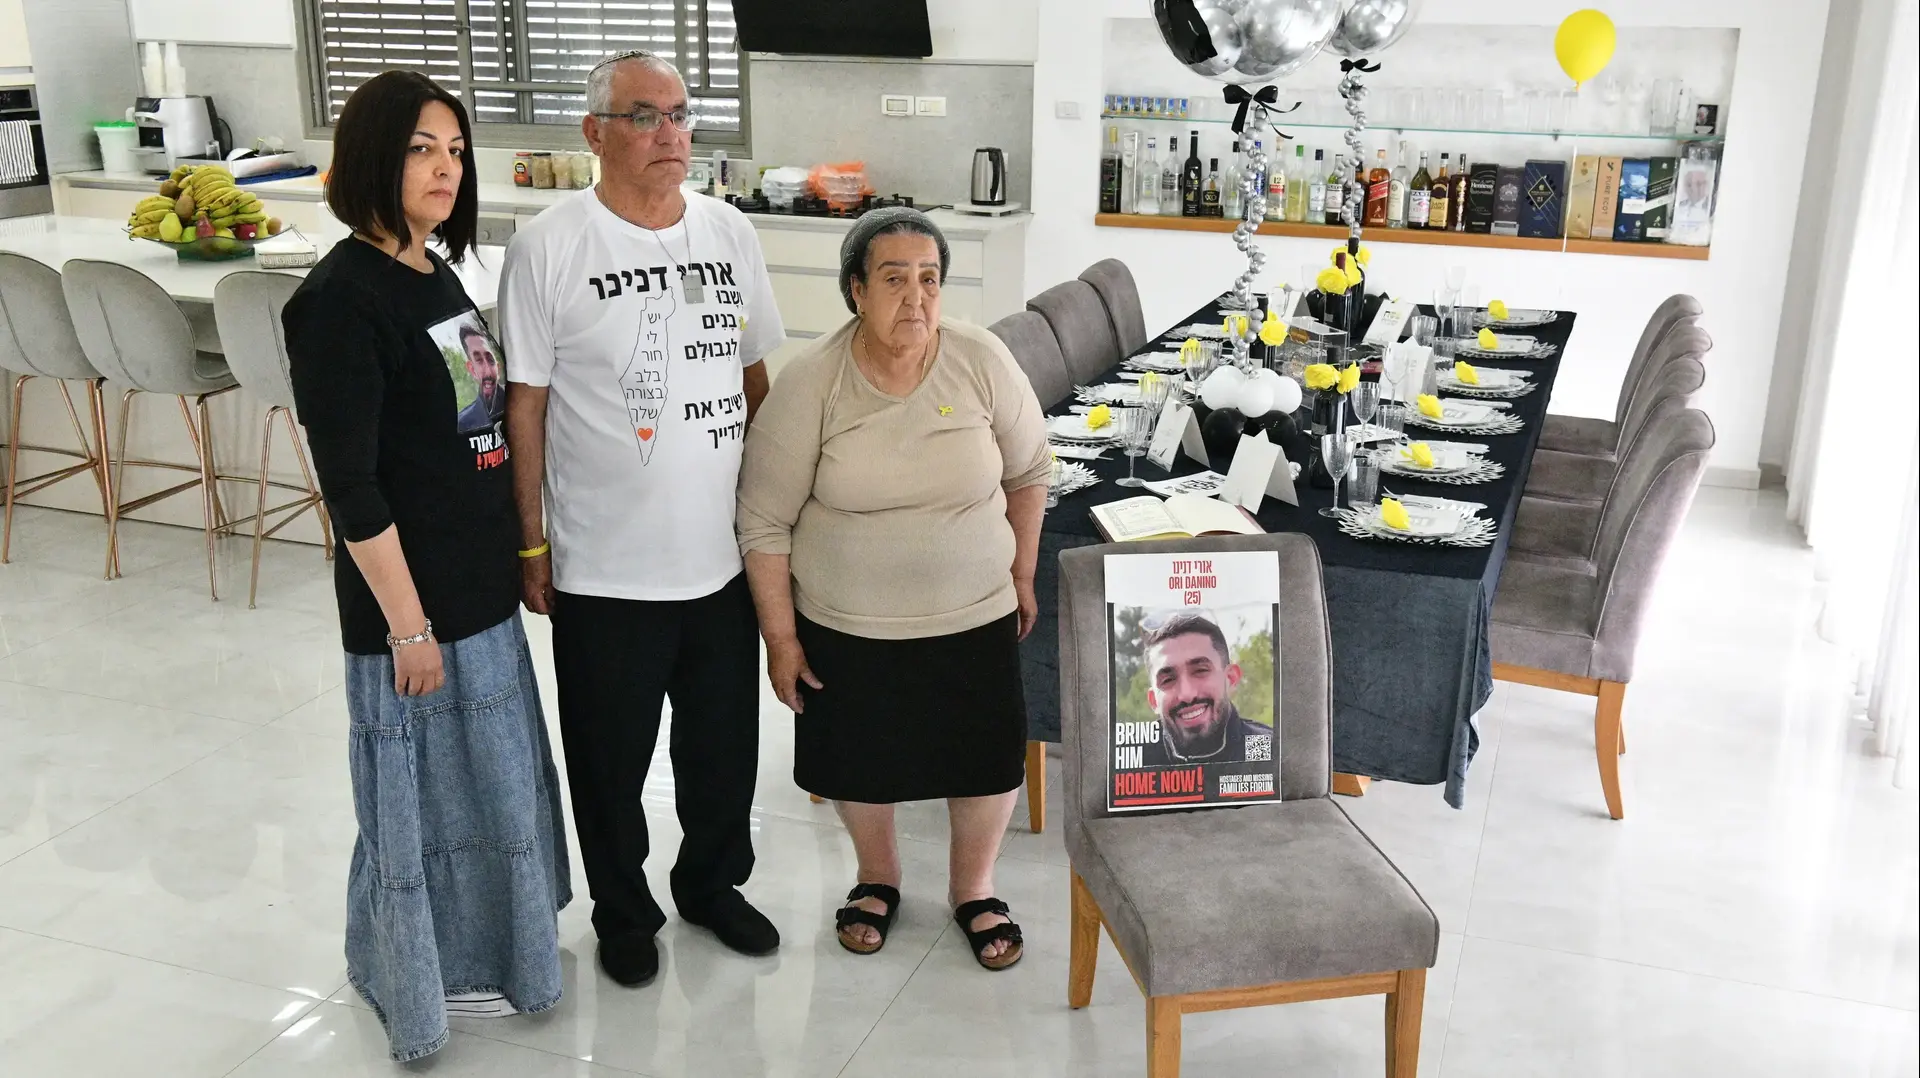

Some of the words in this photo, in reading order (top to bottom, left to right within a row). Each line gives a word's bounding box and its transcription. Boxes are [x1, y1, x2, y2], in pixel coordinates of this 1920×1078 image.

[676, 262, 736, 286] אורי
[589, 266, 667, 300] דנינו
[647, 313, 661, 324] יש
[646, 330, 658, 344] לי
[641, 350, 663, 361] חור
[635, 368, 661, 383] בלב
[626, 387, 664, 400] בצורה
[684, 400, 715, 421] את
[718, 392, 743, 414] שיבי
[630, 406, 658, 422] שלך
[707, 420, 744, 449] ילדייך
[469, 433, 494, 453] אורי
[1172, 561, 1192, 574] דנינו
[1194, 560, 1212, 574] אורי
[1168, 576, 1183, 590] ORI
[1185, 575, 1217, 589] DANINO
[1184, 590, 1202, 606] (25)
[1115, 721, 1160, 745] BRING
[1115, 745, 1144, 770] HIM
[1115, 771, 1157, 796] HOME
[1160, 766, 1204, 794] NOW!
[1219, 774, 1243, 783] HOSTAGES
[1243, 774, 1253, 782] AND
[1253, 773, 1274, 782] MISSING
[1219, 782, 1249, 794] FAMILIES
[1250, 781, 1274, 793] FORUM
